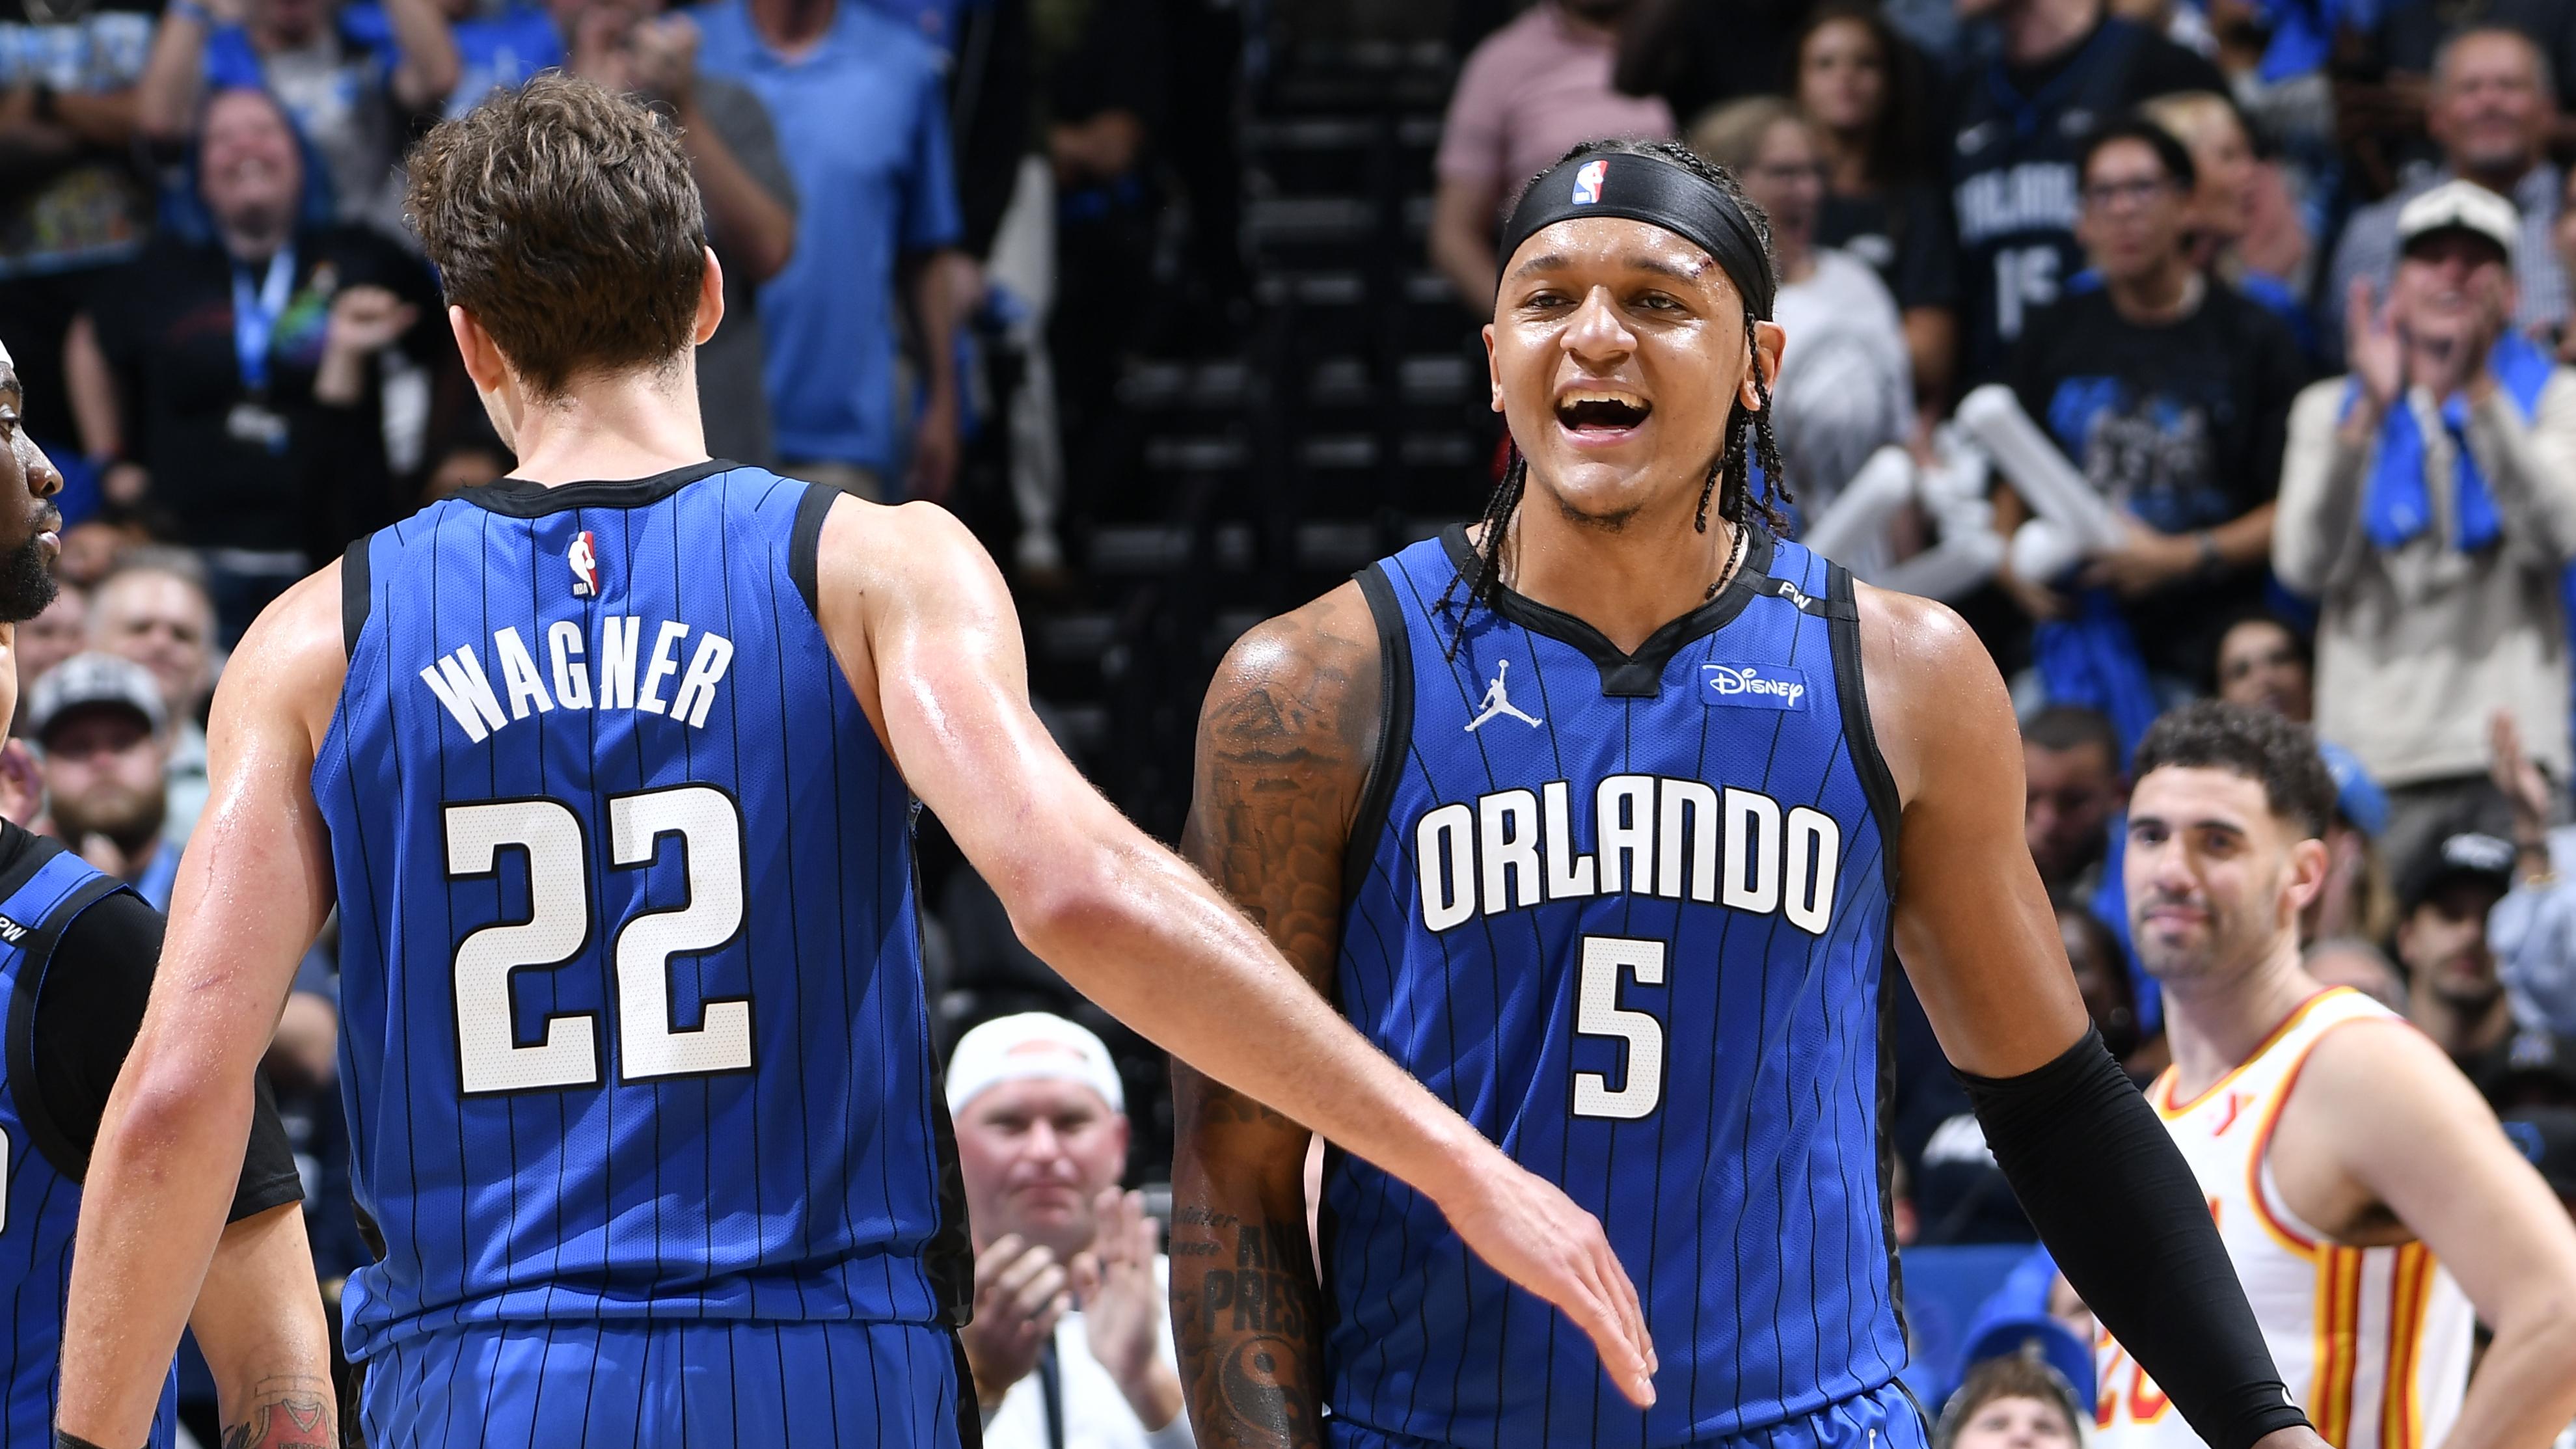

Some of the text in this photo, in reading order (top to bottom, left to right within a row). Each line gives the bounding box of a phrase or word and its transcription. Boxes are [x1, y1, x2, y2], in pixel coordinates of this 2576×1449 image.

[573, 582, 588, 595] NBA
[1778, 581, 1811, 609] PW
[420, 616, 734, 743] WAGNER
[1416, 774, 1840, 935] ORLANDO
[0, 916, 27, 942] PW
[442, 783, 755, 1097] 22
[1572, 935, 1667, 1120] 5
